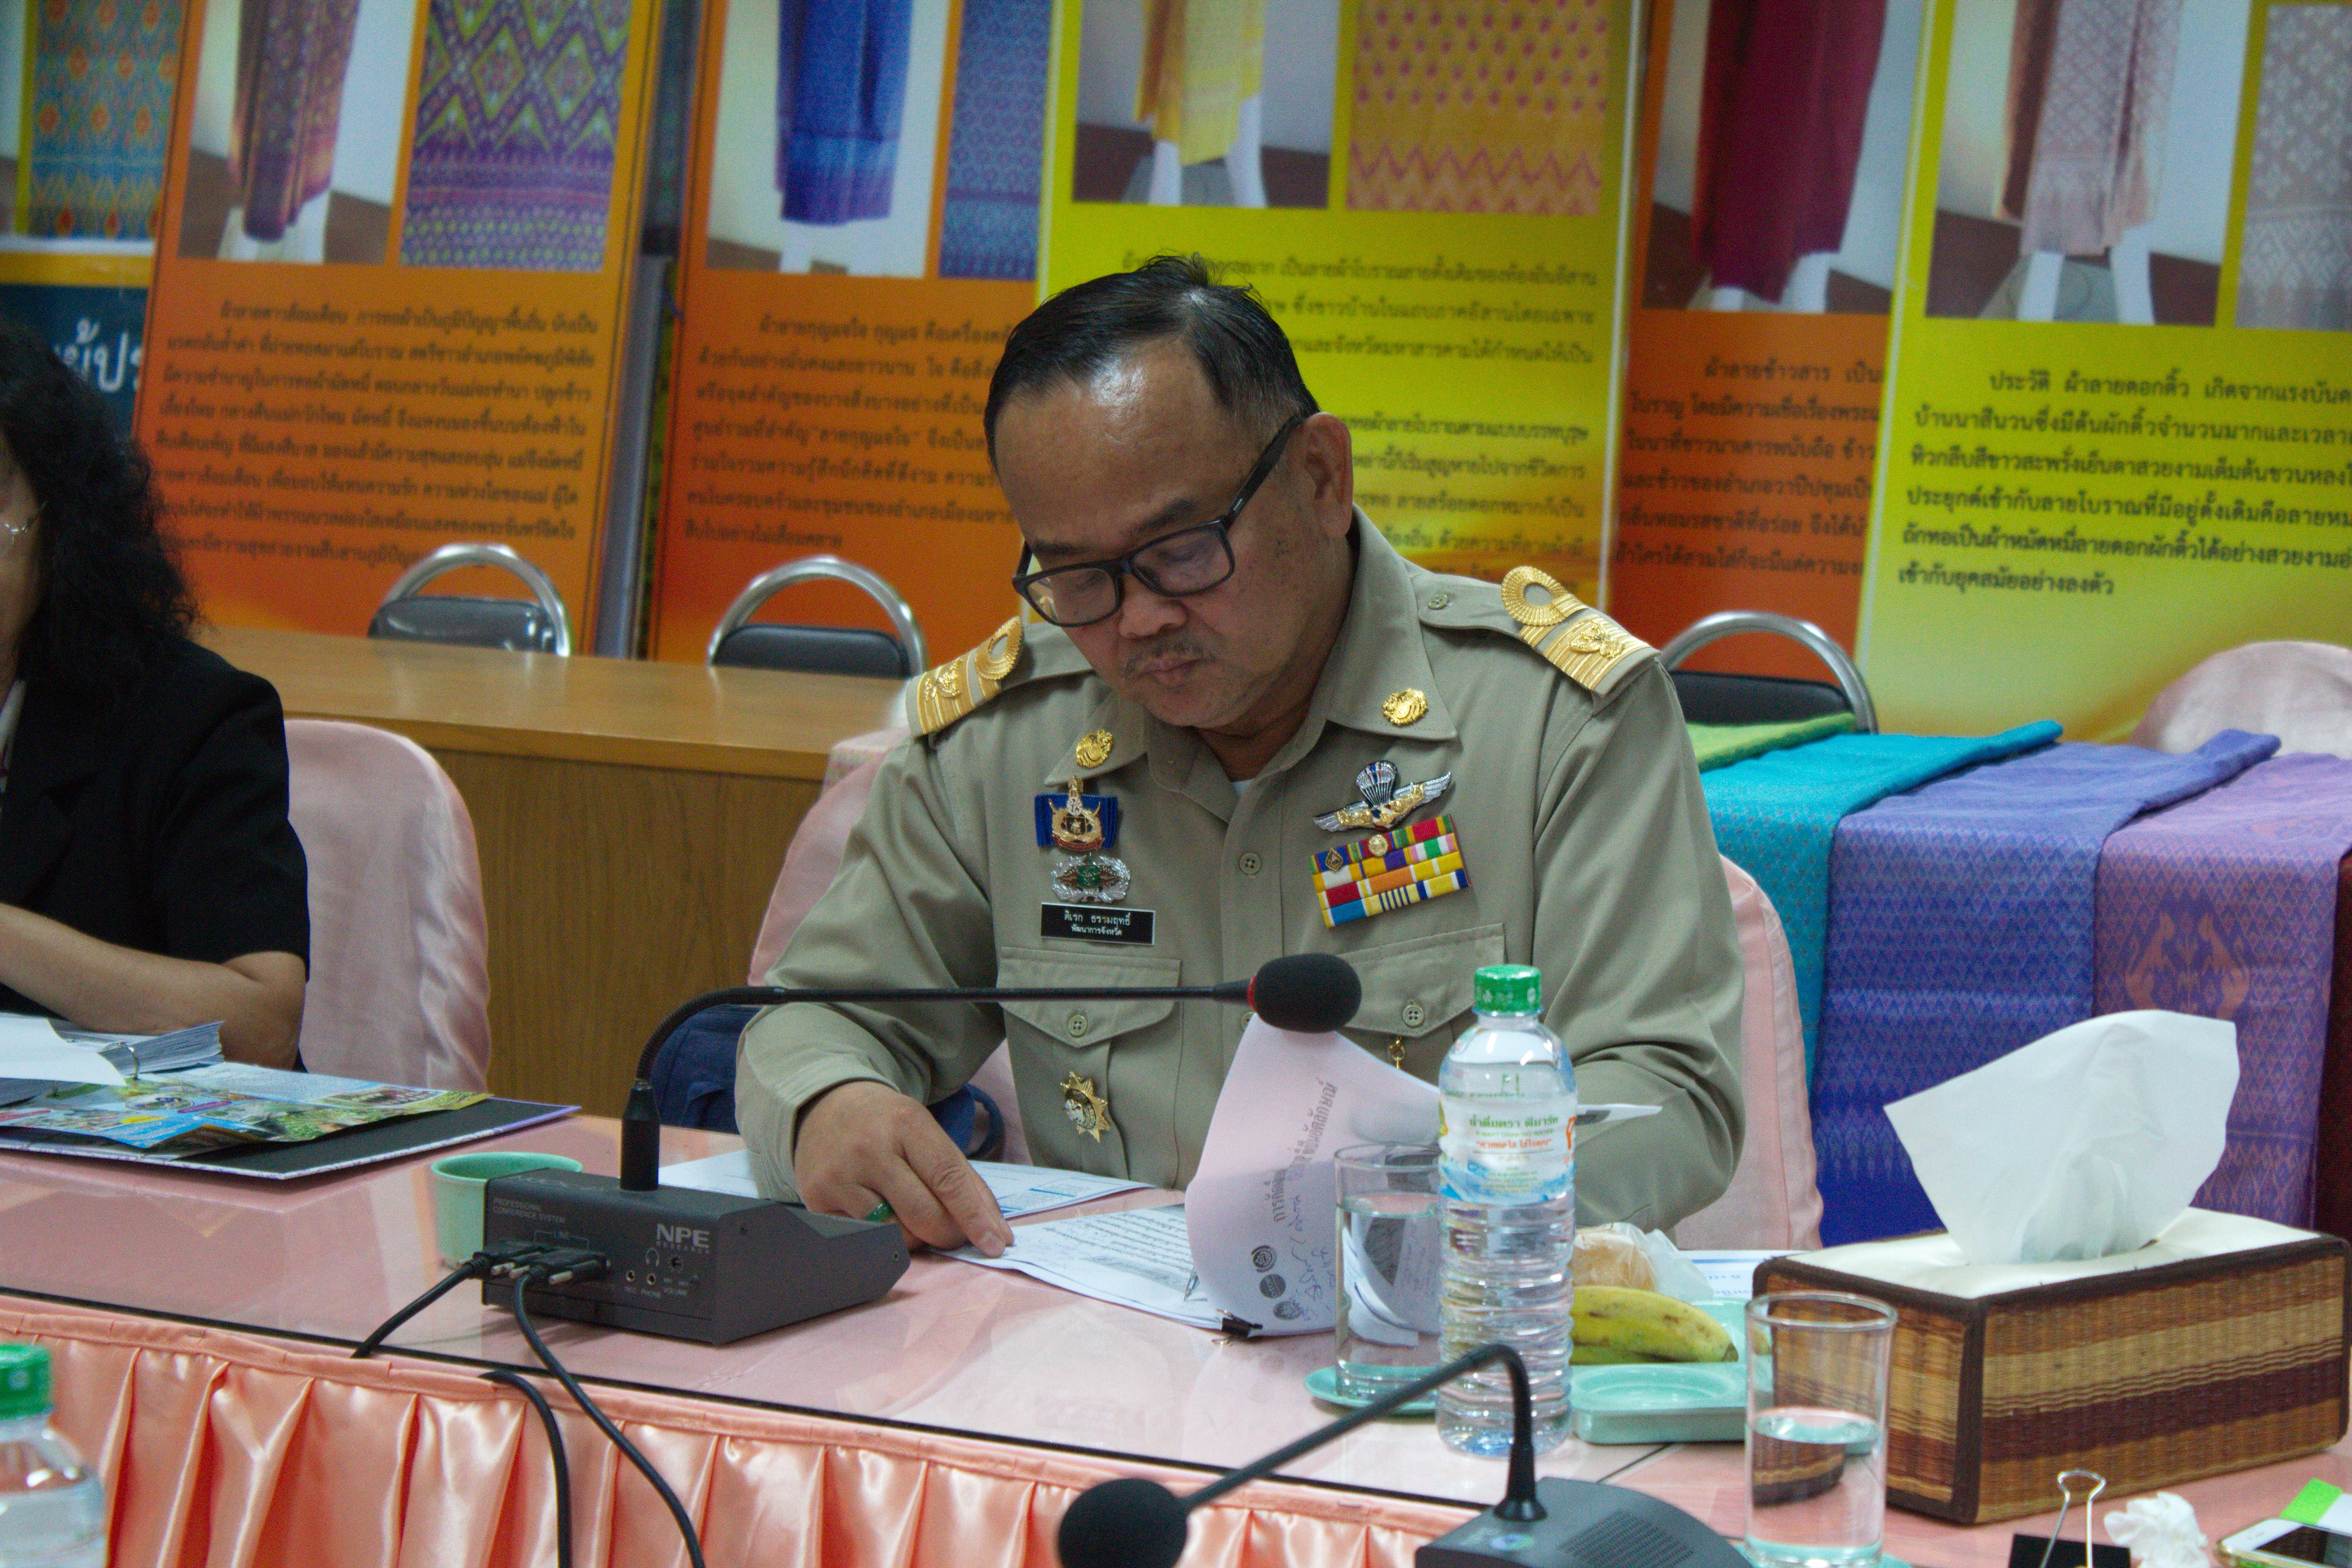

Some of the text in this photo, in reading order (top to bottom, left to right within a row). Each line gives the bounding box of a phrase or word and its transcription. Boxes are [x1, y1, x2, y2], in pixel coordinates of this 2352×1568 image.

[1990, 369, 2051, 393] ประวัติ
[2065, 367, 2190, 399] ผ้าลายดอกติ้ว
[1915, 402, 2352, 445] บ้านนาสีนวนซึ่งมีต้นผักติ้วจำนวนมากและเวลา
[1898, 560, 2115, 596] เข้ากับยุคสมัยอย่างลงตัว
[1071, 925, 1122, 936] พัฒนาการจังหวัด
[1091, 912, 1131, 926] ธรรมฤทธิ์
[492, 1206, 565, 1224] CONFERENCE SYSTEM
[656, 1223, 710, 1249] NPE
